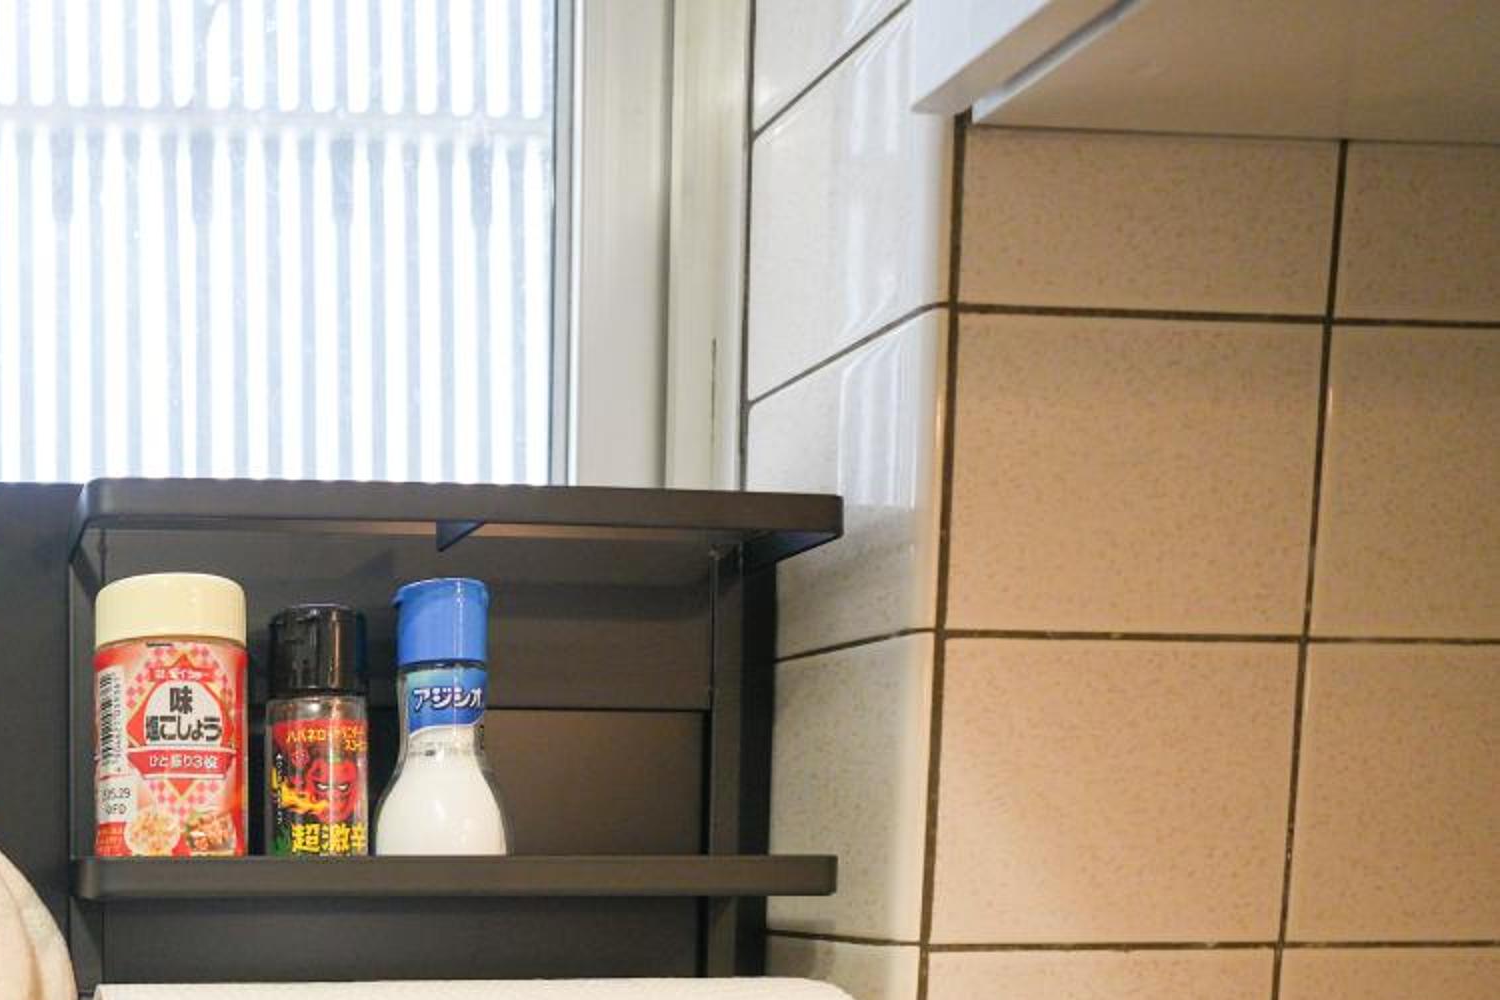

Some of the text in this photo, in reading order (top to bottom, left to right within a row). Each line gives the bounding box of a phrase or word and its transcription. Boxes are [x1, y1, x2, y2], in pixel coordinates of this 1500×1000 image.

[168, 685, 192, 714] 味
[413, 687, 482, 711] アジシオ
[292, 822, 366, 853] 超激辛
